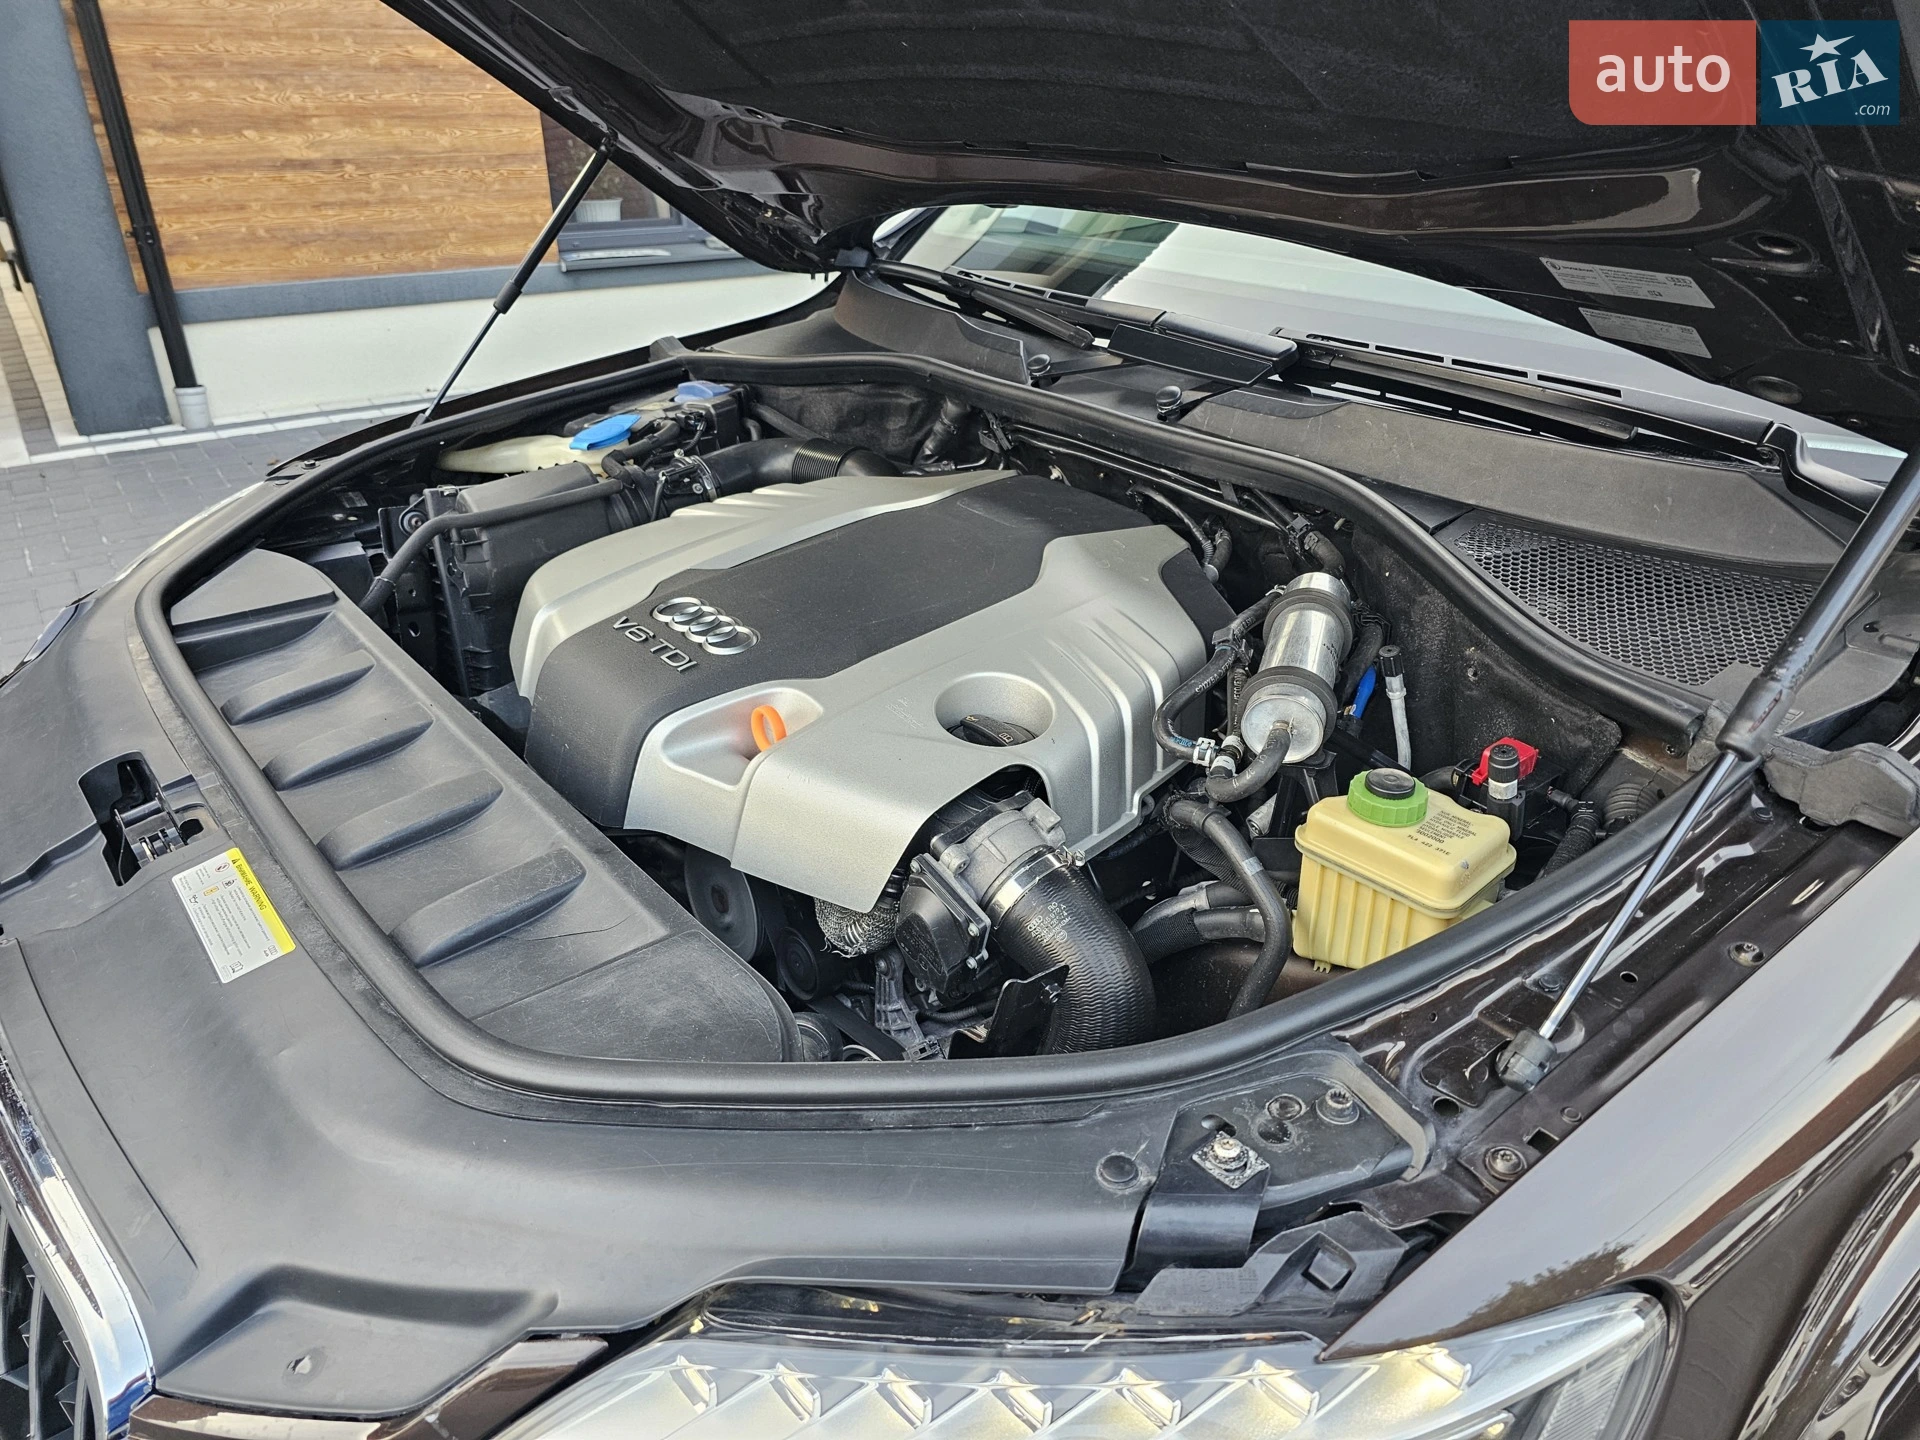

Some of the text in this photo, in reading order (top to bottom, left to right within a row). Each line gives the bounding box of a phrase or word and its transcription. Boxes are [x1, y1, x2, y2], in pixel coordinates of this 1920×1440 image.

[613, 616, 697, 672] V6 TDI
[249, 885, 267, 911] WARNING
